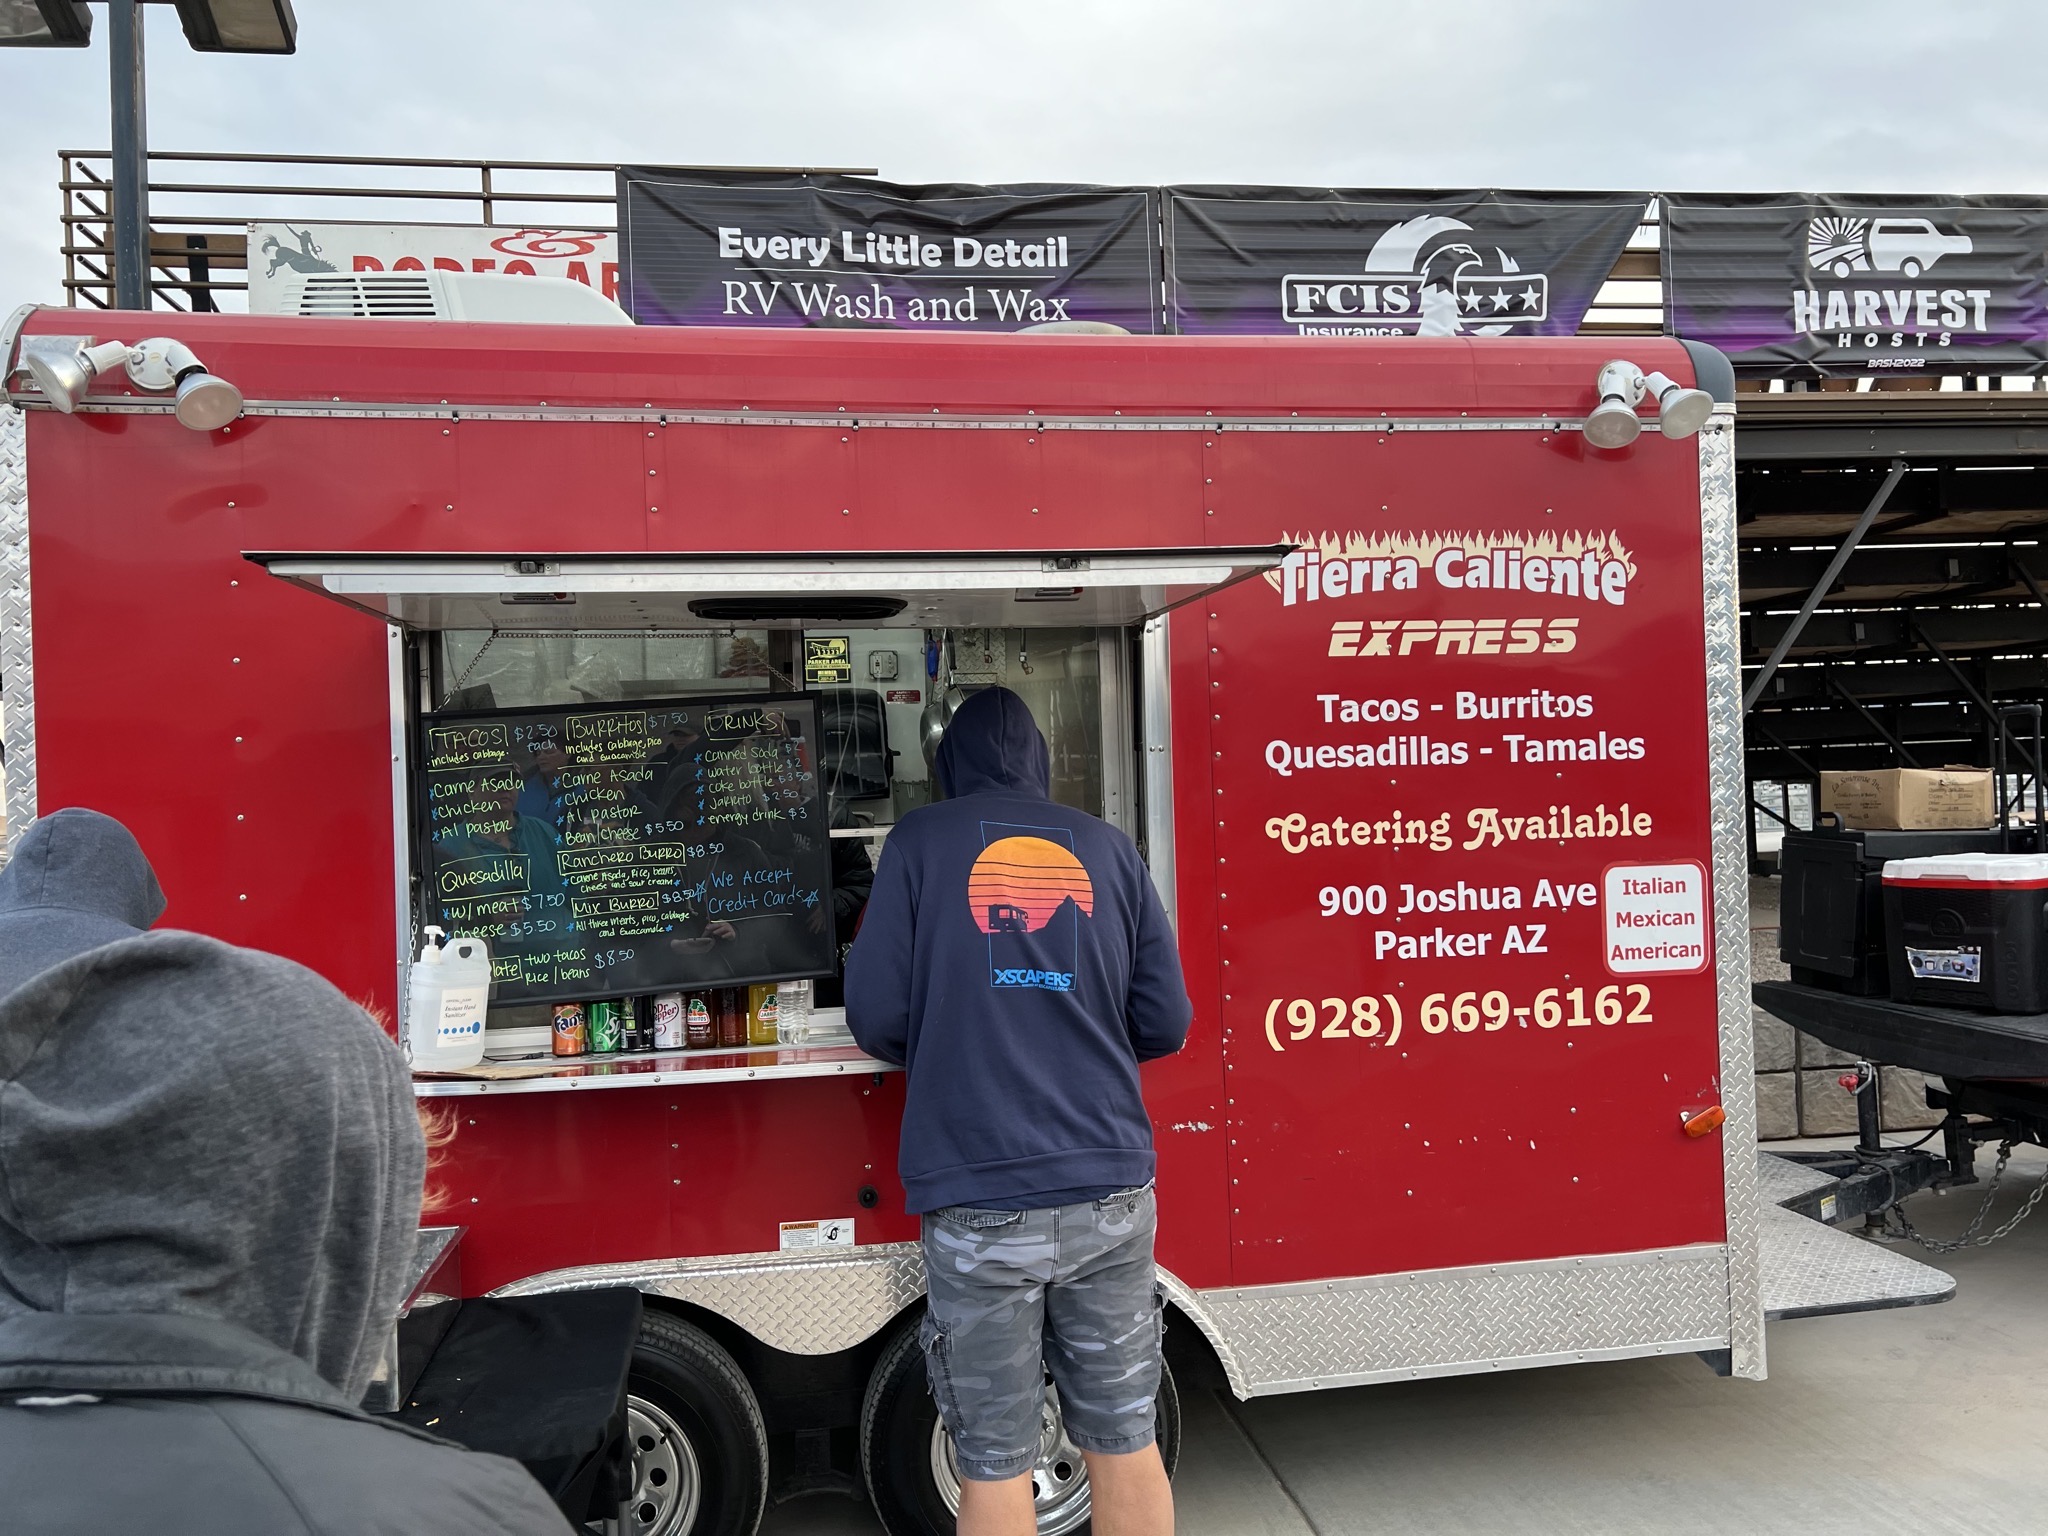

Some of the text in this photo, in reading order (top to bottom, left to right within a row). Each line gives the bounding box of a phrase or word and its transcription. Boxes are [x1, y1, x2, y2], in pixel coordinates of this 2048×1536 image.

[718, 227, 1069, 268] Every Little Detail
[722, 280, 1071, 322] RV Wash and Wax
[1293, 284, 1412, 314] FCIS
[1793, 289, 1991, 334] HARVEST
[1299, 323, 1404, 336] Insurance
[1838, 332, 1952, 348] HOSTS
[1867, 358, 1926, 368] BASH2022
[1279, 547, 1627, 607] Tierra Caliente
[1328, 617, 1580, 657] EXPRESS
[1317, 693, 1419, 723] Tacos
[1456, 689, 1594, 720] Burritos
[708, 711, 778, 732] DRINKS
[435, 728, 503, 749] TACOS
[431, 751, 470, 767] includes
[1264, 735, 1469, 777] Quesadillas
[1502, 731, 1646, 763] Tamales
[609, 765, 654, 783] Asada
[707, 765, 742, 778] water
[747, 759, 784, 774] bottle
[739, 774, 775, 790] bottle
[564, 787, 625, 806] Chicken
[438, 800, 501, 819] Chicken
[708, 807, 807, 826] energy drink $3
[1264, 803, 1653, 854] Catering Available
[441, 859, 524, 893] Quesadilla
[711, 867, 794, 888] We Accept
[1622, 877, 1687, 896] Italian
[477, 897, 520, 916] meat
[708, 884, 803, 914] Credit Cards
[1318, 878, 1597, 917] 900 Joshua Ave
[1615, 909, 1696, 929] Mexican
[1374, 924, 1548, 960] Parker AZ
[1610, 941, 1702, 962] American
[492, 959, 519, 978] late
[524, 953, 550, 966] two
[553, 947, 586, 962] tacos
[993, 969, 1074, 987] XSCAPERS
[1264, 983, 1653, 1052] (928) 669-6162
